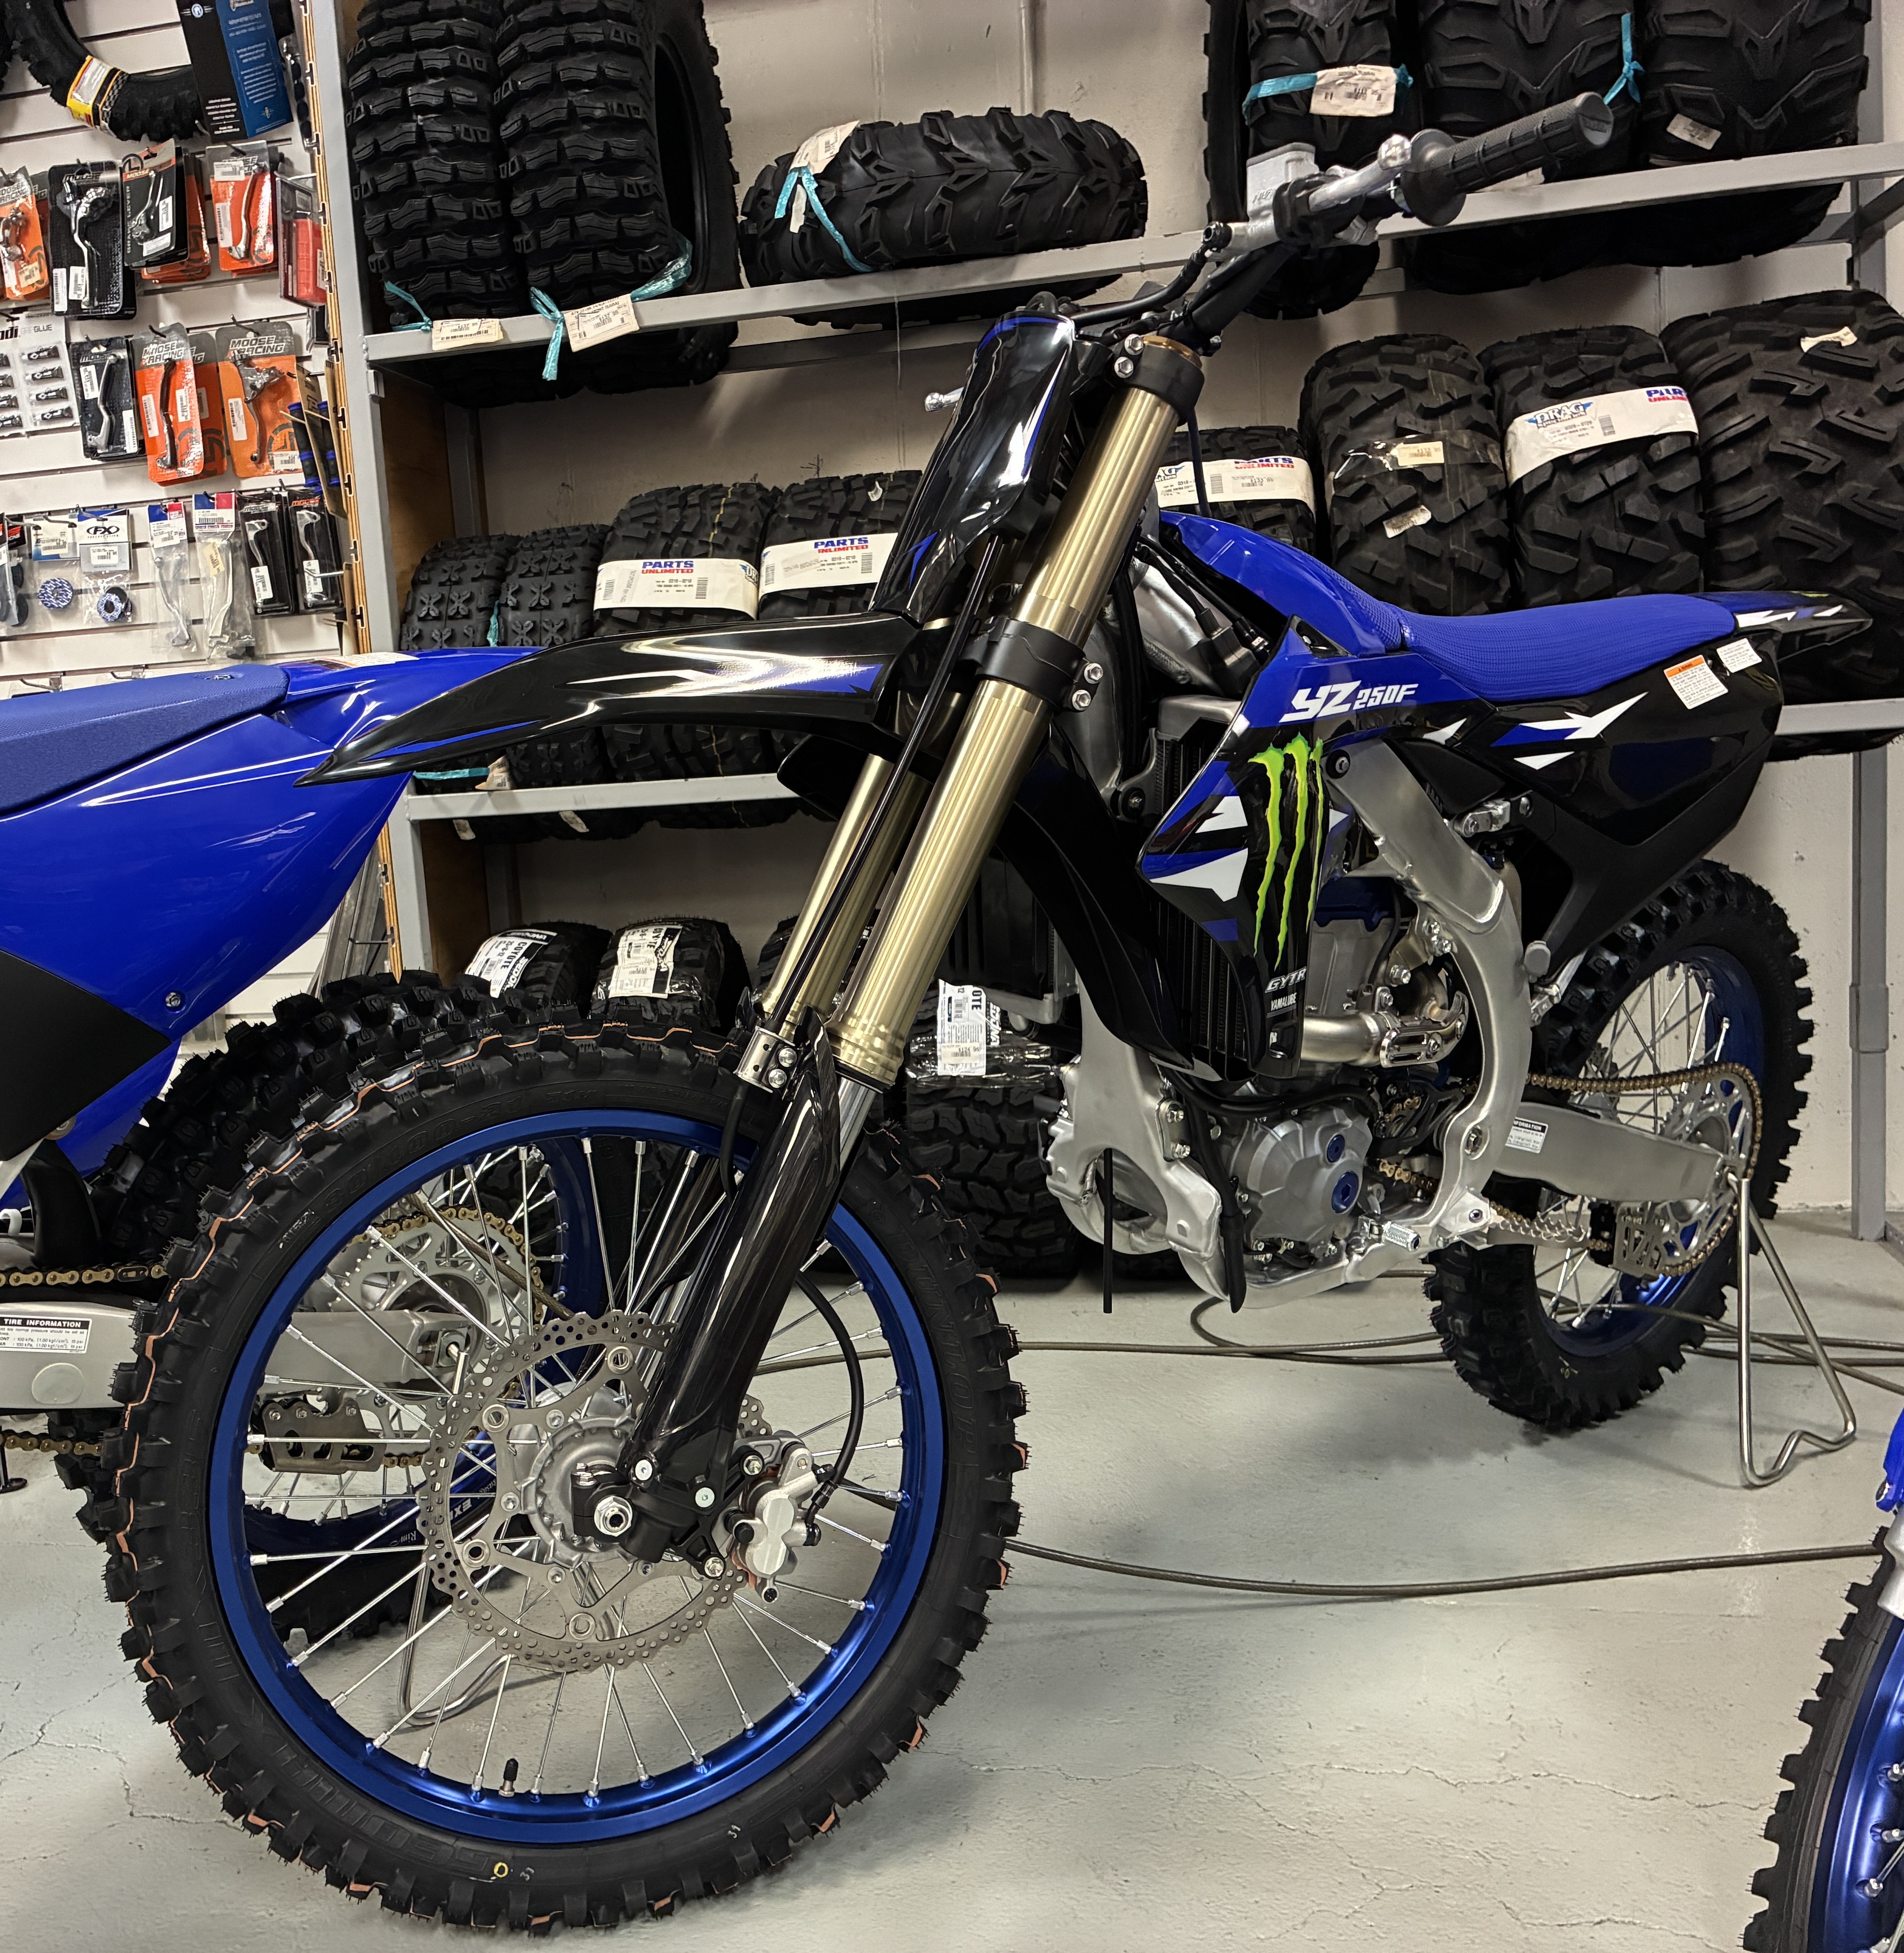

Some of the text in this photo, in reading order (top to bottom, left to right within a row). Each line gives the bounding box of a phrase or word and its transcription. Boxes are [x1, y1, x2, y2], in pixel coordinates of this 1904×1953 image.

[34, 324, 52, 333] GLUE
[230, 335, 276, 350] MOOSE
[1535, 403, 1585, 423] DRAG
[814, 537, 869, 548] PARTS
[1279, 680, 1419, 723] YZ 250F
[500, 941, 528, 969] COYOTE
[1265, 966, 1307, 993] GYTR
[972, 990, 983, 1011] OTE
[1271, 992, 1297, 1012] YAMALUBE
[990, 1002, 1002, 1046] EDONA
[26, 1319, 81, 1328] INFORMATION
[401, 1530, 417, 1543] Rim
